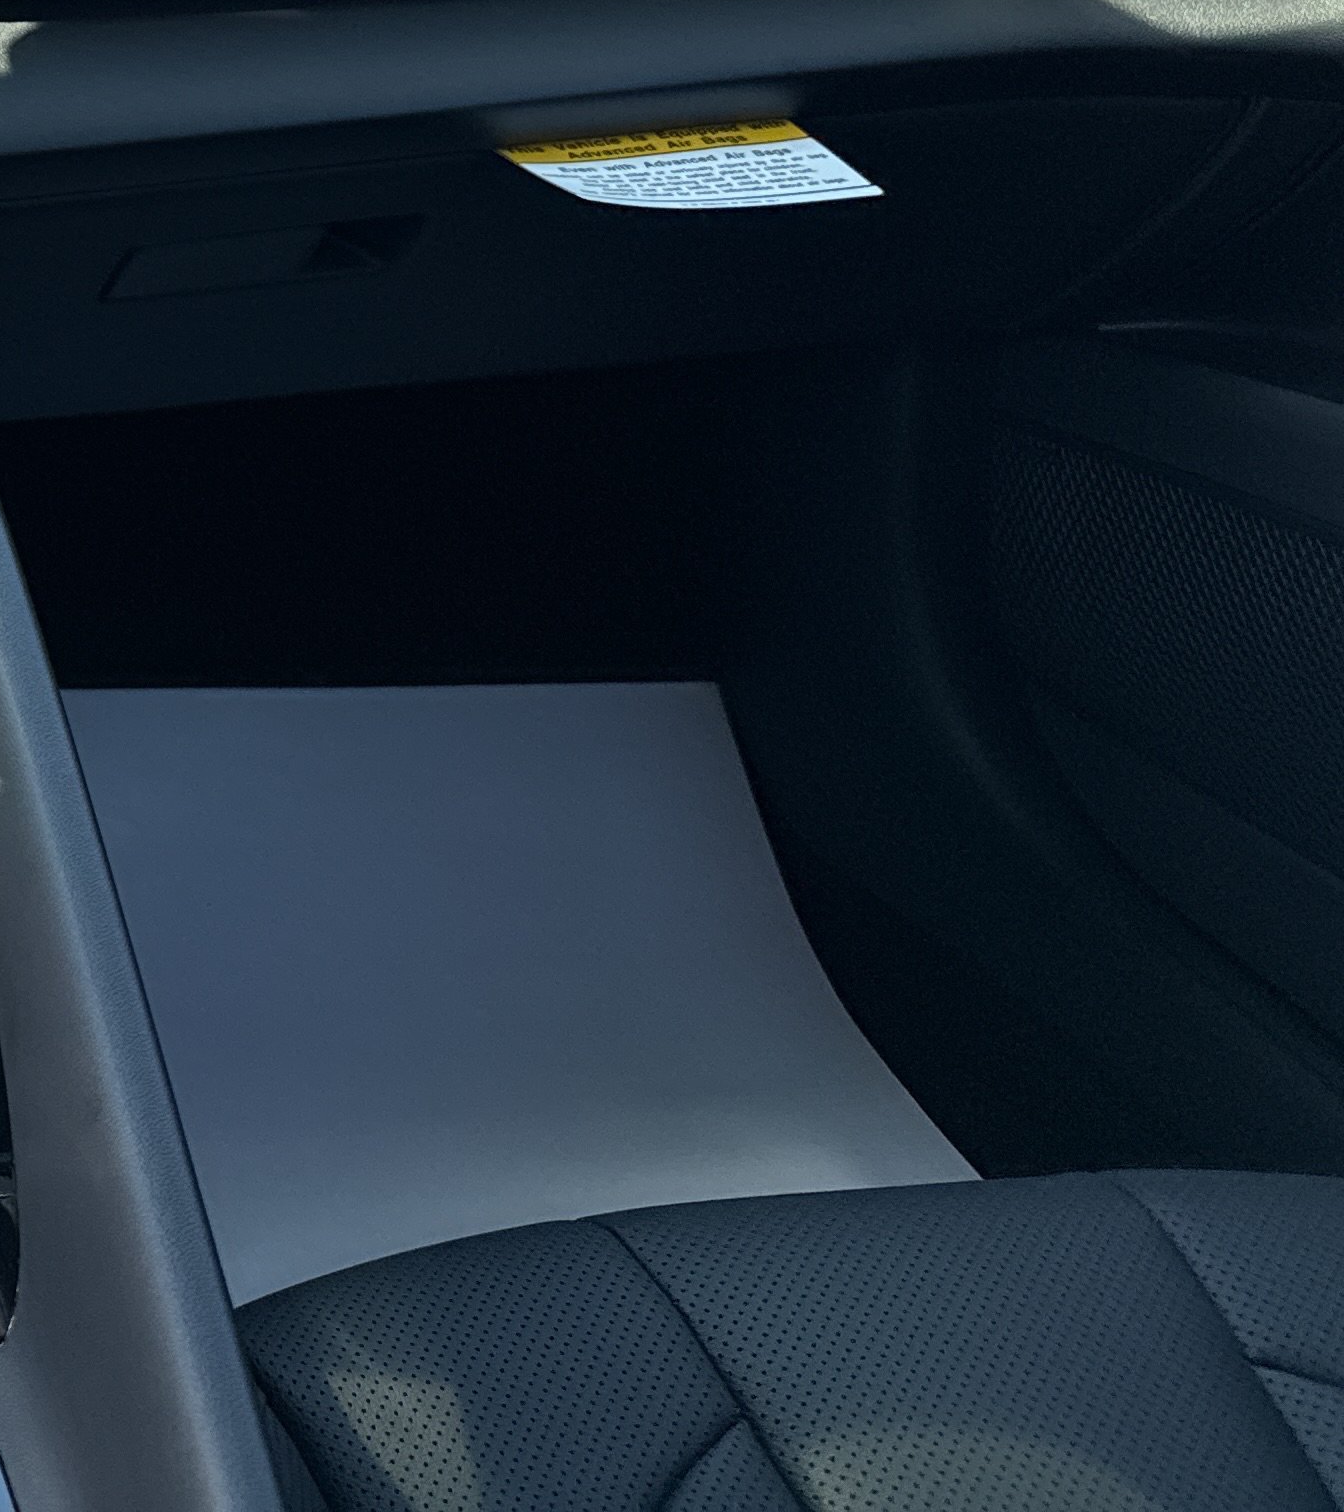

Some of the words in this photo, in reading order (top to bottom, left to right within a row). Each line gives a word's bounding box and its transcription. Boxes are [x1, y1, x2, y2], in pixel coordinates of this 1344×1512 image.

[567, 143, 657, 160] Advanced
[667, 139, 692, 149] Air
[700, 134, 748, 145] Bags
[557, 165, 598, 174] Even
[602, 163, 637, 172] with
[643, 154, 719, 169] Advanced
[724, 151, 746, 160] Air
[751, 147, 792, 157] Bags
